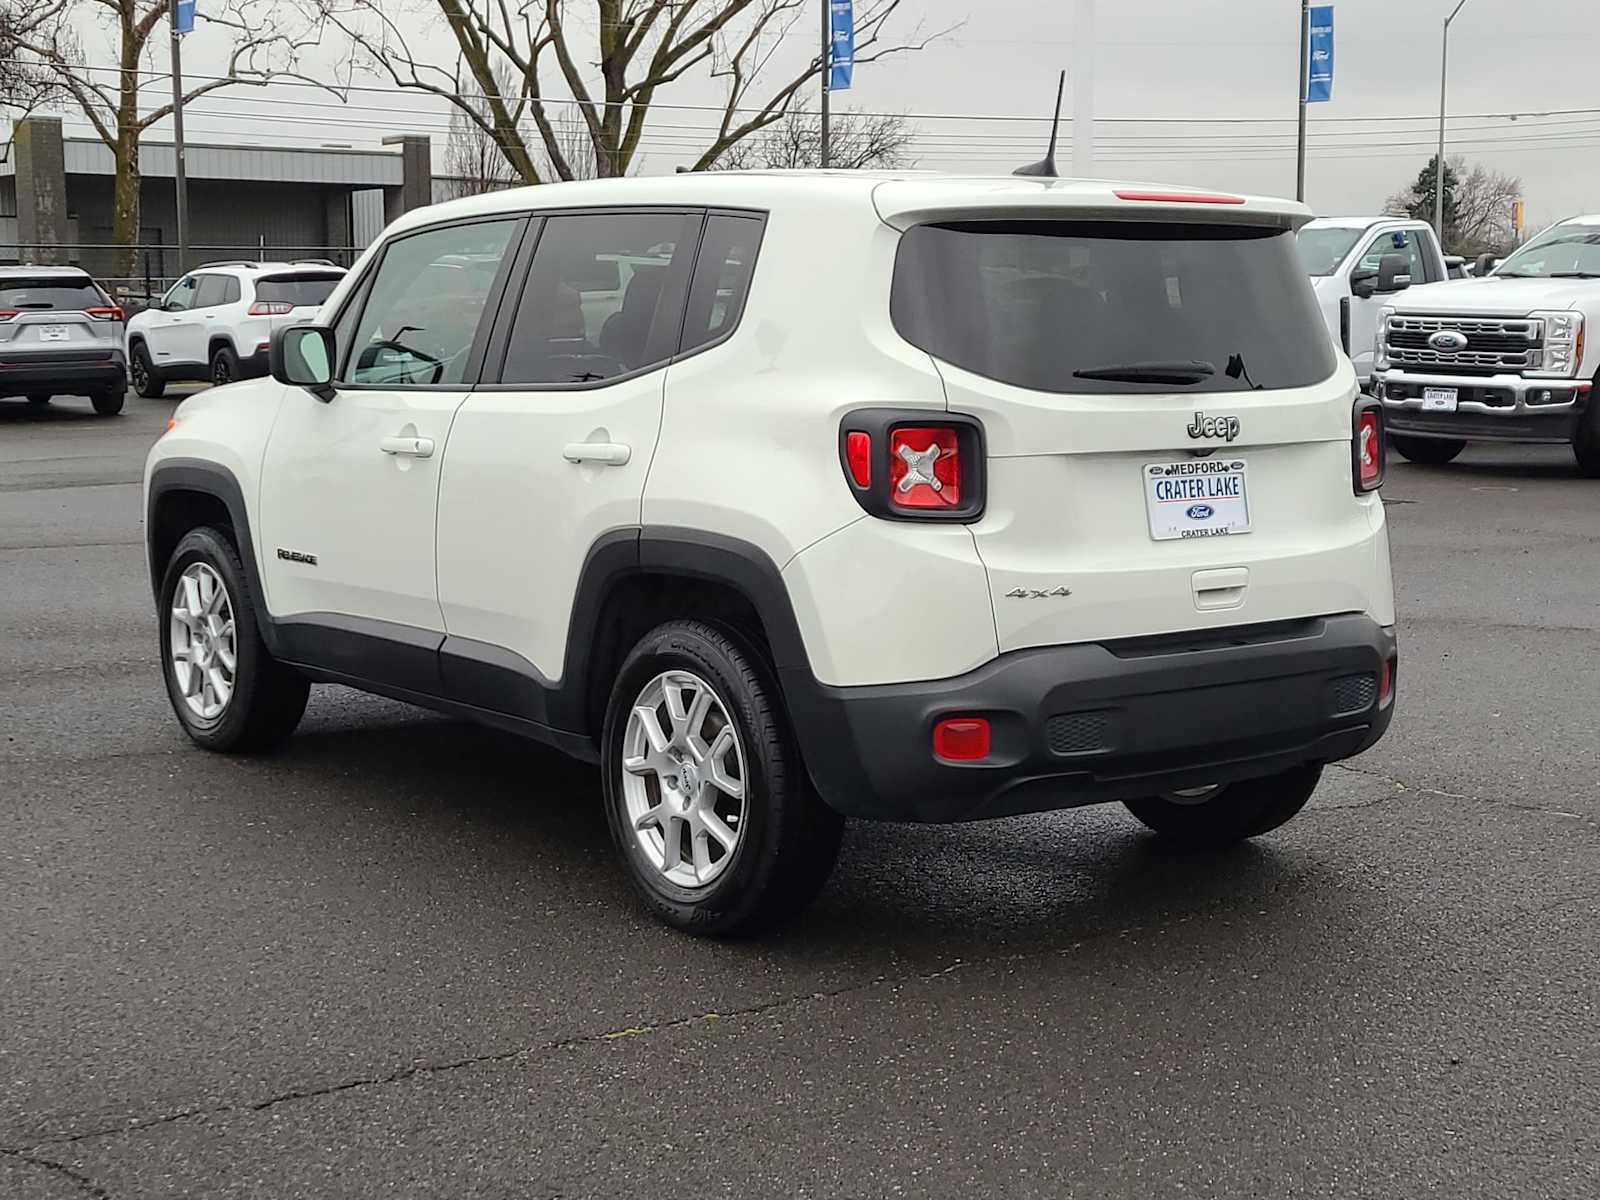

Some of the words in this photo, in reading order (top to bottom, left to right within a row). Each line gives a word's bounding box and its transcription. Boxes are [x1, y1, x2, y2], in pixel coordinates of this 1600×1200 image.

[1187, 411, 1240, 442] Jeep
[1170, 461, 1224, 475] MEDFORD
[1156, 479, 1205, 500] CRATER
[1208, 476, 1240, 497] LAKE
[1181, 528, 1209, 538] CRATER
[1210, 526, 1230, 536] LAKE
